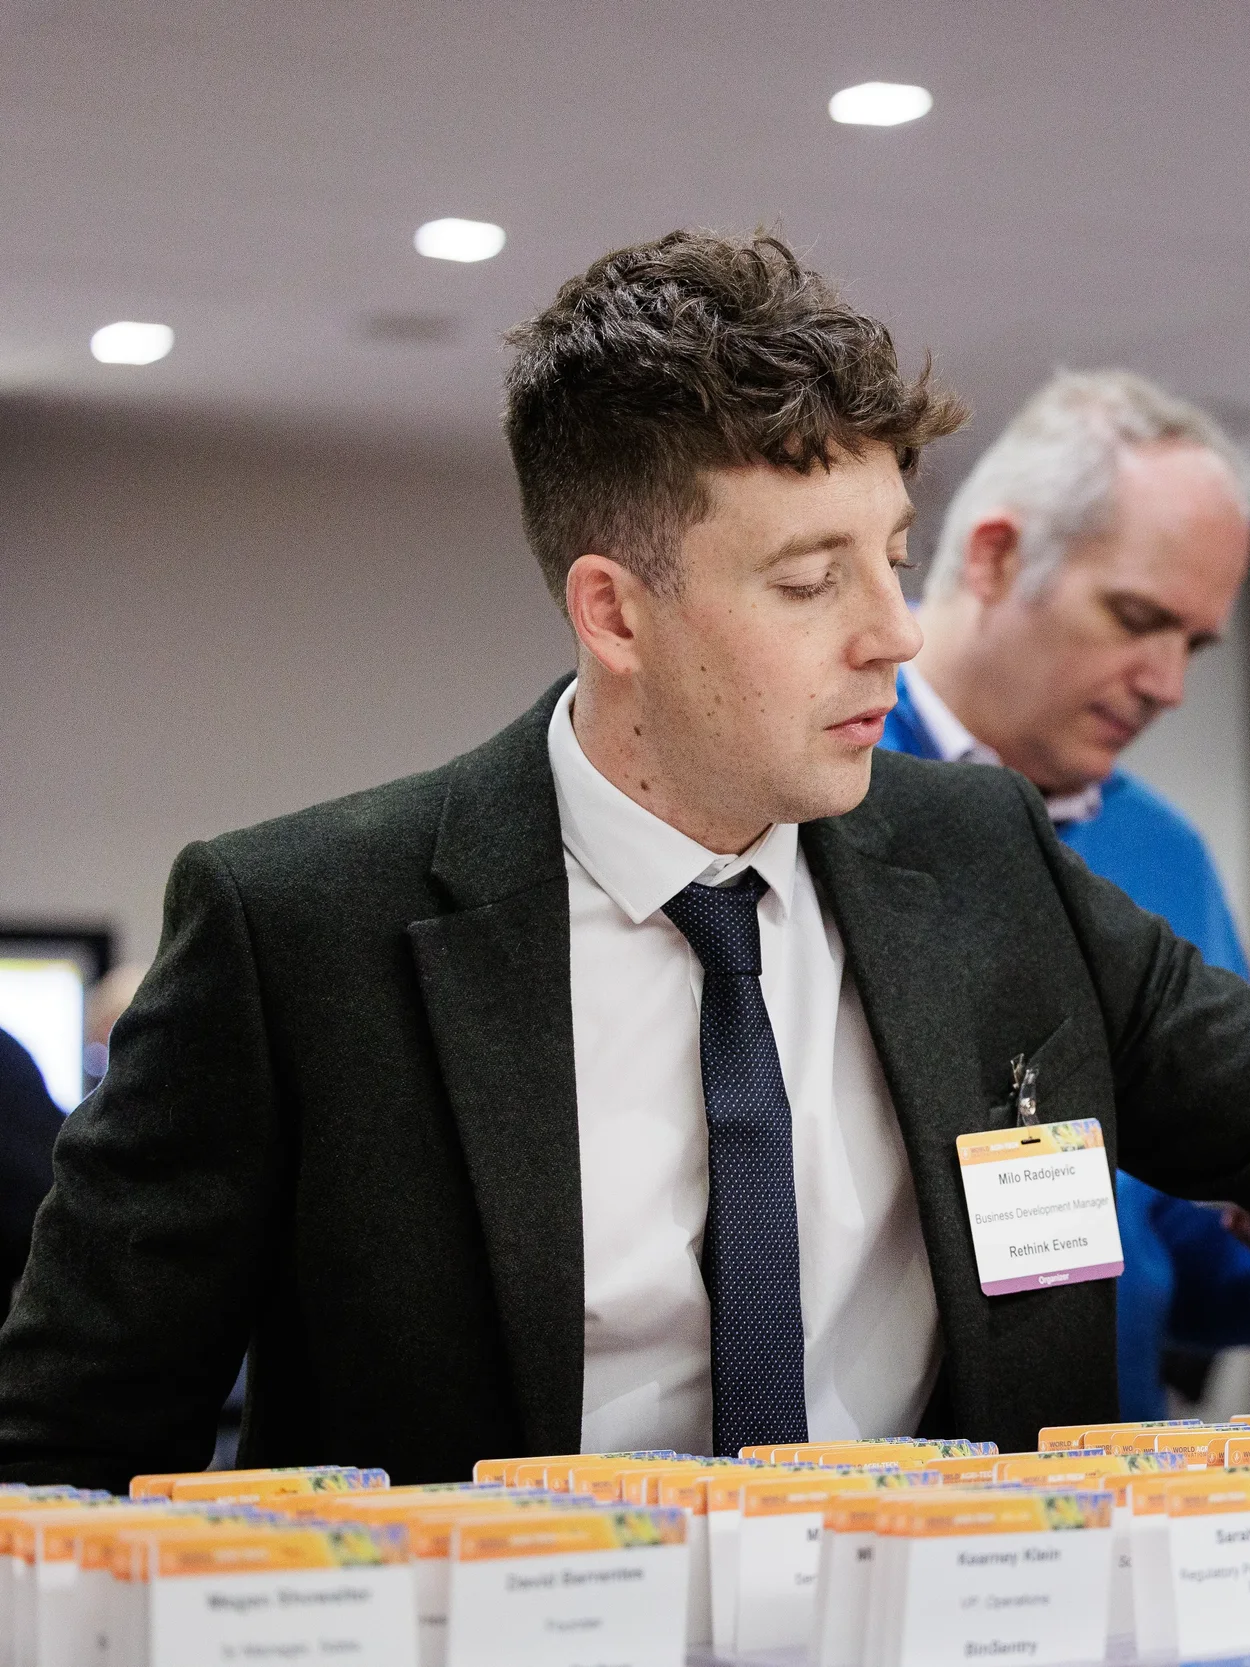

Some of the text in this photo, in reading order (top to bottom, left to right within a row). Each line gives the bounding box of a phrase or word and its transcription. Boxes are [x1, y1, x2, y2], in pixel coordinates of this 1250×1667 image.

[998, 1165, 1076, 1185] Milo Radojevic
[975, 1196, 1109, 1224] Business Development Manager
[1009, 1236, 1088, 1258] Rethink Events
[1179, 1564, 1240, 1583] Regulatory
